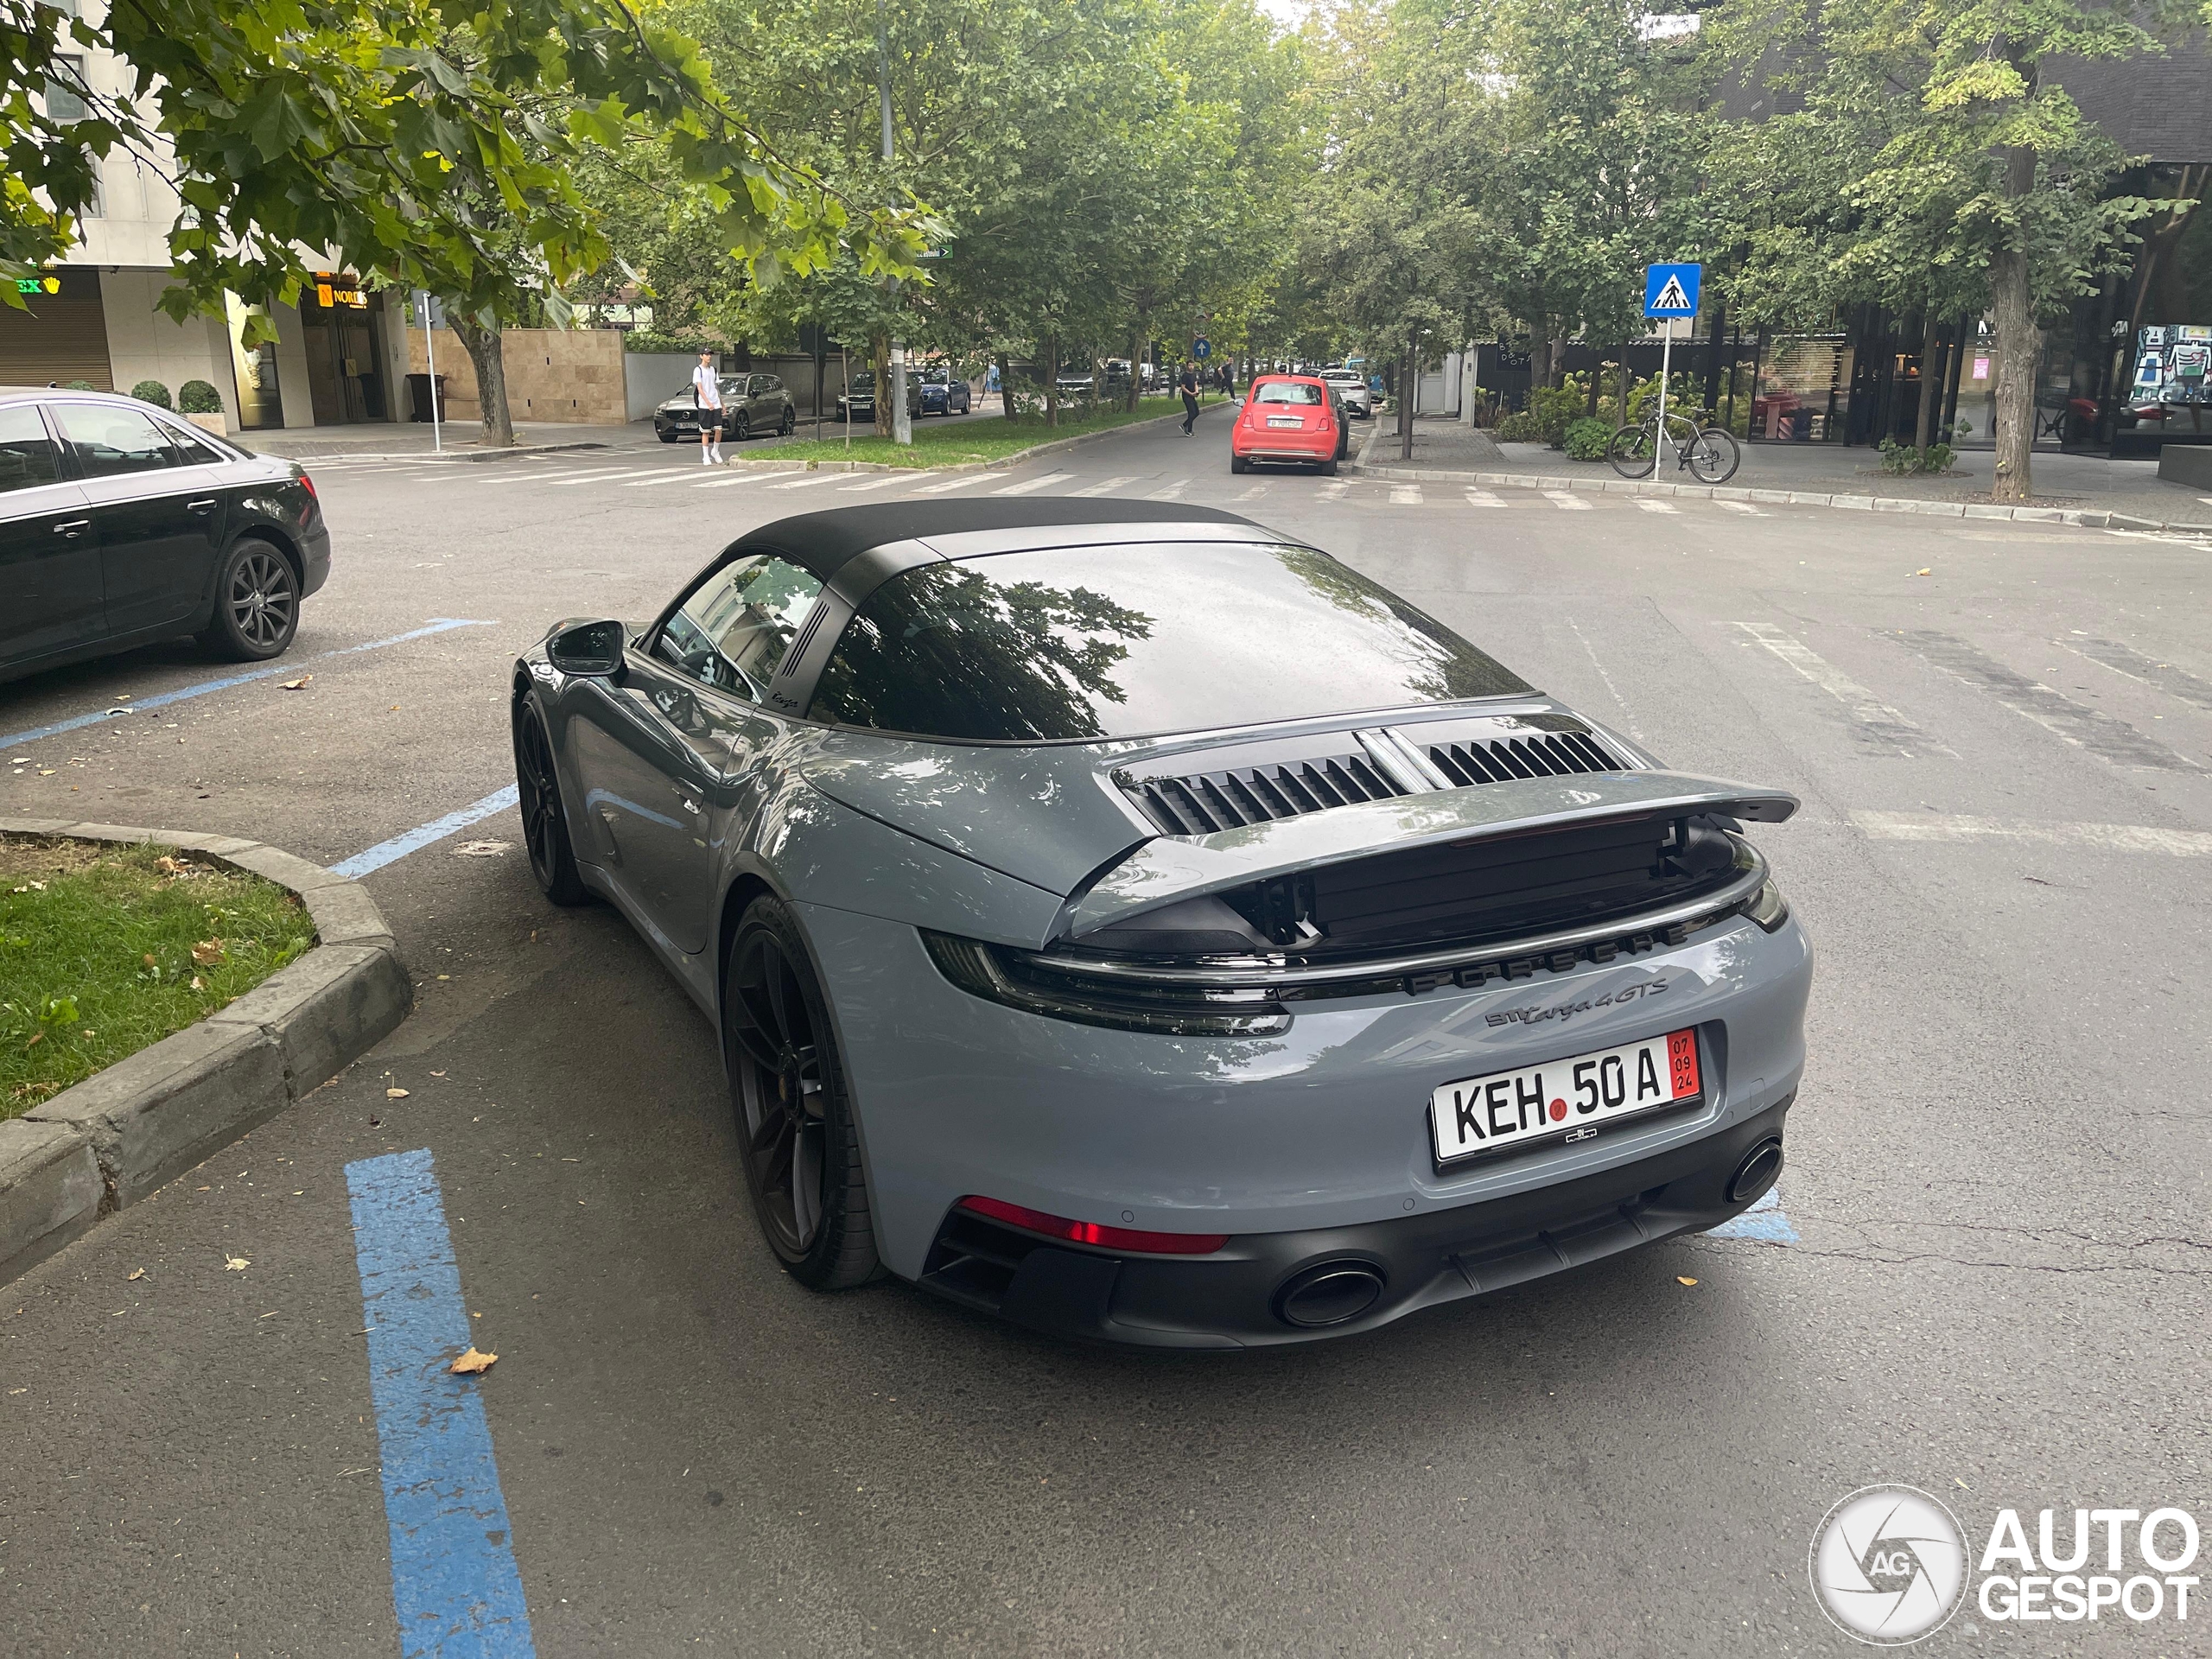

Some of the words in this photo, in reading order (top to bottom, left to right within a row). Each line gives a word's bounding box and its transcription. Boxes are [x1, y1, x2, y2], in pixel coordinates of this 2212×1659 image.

[16, 279, 43, 294] EX
[1402, 925, 1688, 996] PORSCHE
[1484, 1007, 1526, 1027] 911
[1594, 992, 1613, 1007] 4
[1614, 977, 1669, 1004] GTS
[1672, 1038, 1688, 1055] 07
[1675, 1057, 1691, 1073] 09
[1676, 1074, 1694, 1091] 24
[1453, 1073, 1547, 1144] KEH
[1573, 1055, 1625, 1115] 50
[1637, 1047, 1661, 1102] A
